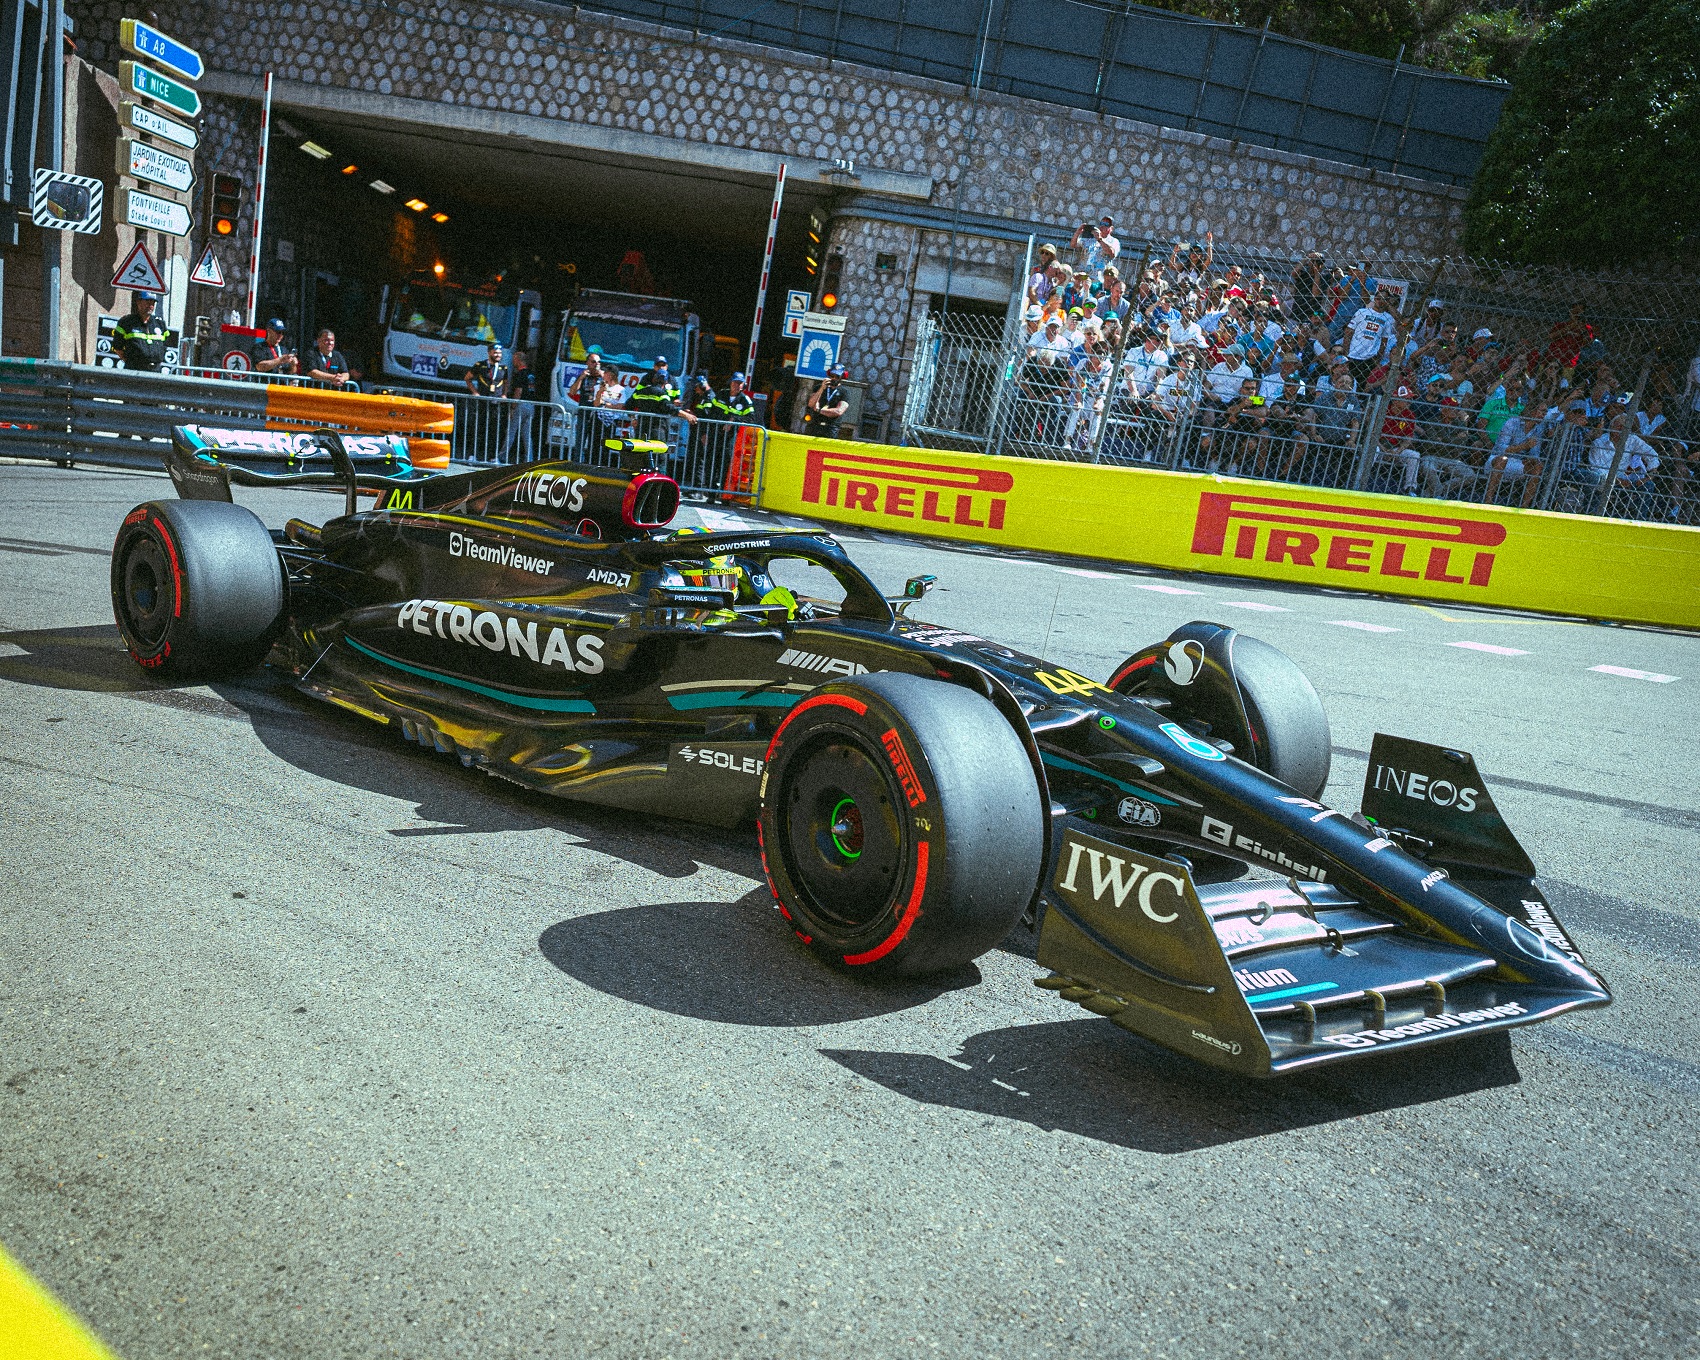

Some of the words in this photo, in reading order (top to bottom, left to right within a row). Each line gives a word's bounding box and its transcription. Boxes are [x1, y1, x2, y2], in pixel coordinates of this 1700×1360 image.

[152, 38, 166, 56] A8
[149, 77, 170, 98] NICE
[134, 110, 149, 125] CAP
[132, 145, 156, 163] JARDIN
[157, 154, 188, 175] EXOTIQUE
[141, 161, 168, 181] HÔPITAL
[131, 195, 171, 216] FONTVIEILLE
[130, 209, 149, 223] Stade
[150, 213, 167, 227] Louis
[182, 468, 219, 486] Snapdragon
[387, 488, 413, 511] 44
[513, 470, 588, 513] INEOS
[801, 448, 1015, 530] PIRELLI
[126, 509, 148, 526] PIRELLI
[707, 539, 771, 554] CROWDSTRIKE
[1190, 491, 1508, 588] PIRELLI
[463, 537, 555, 577] TeamViewer
[586, 568, 619, 587] AMD
[673, 593, 708, 603] PETRONAS
[397, 598, 606, 676] PETRONAS
[1033, 668, 1115, 698] 44
[880, 727, 928, 809] PIRELLI
[1372, 763, 1480, 813] INEOS
[1059, 841, 1186, 924] IWC
[1353, 1001, 1530, 1043] TeamViewer
